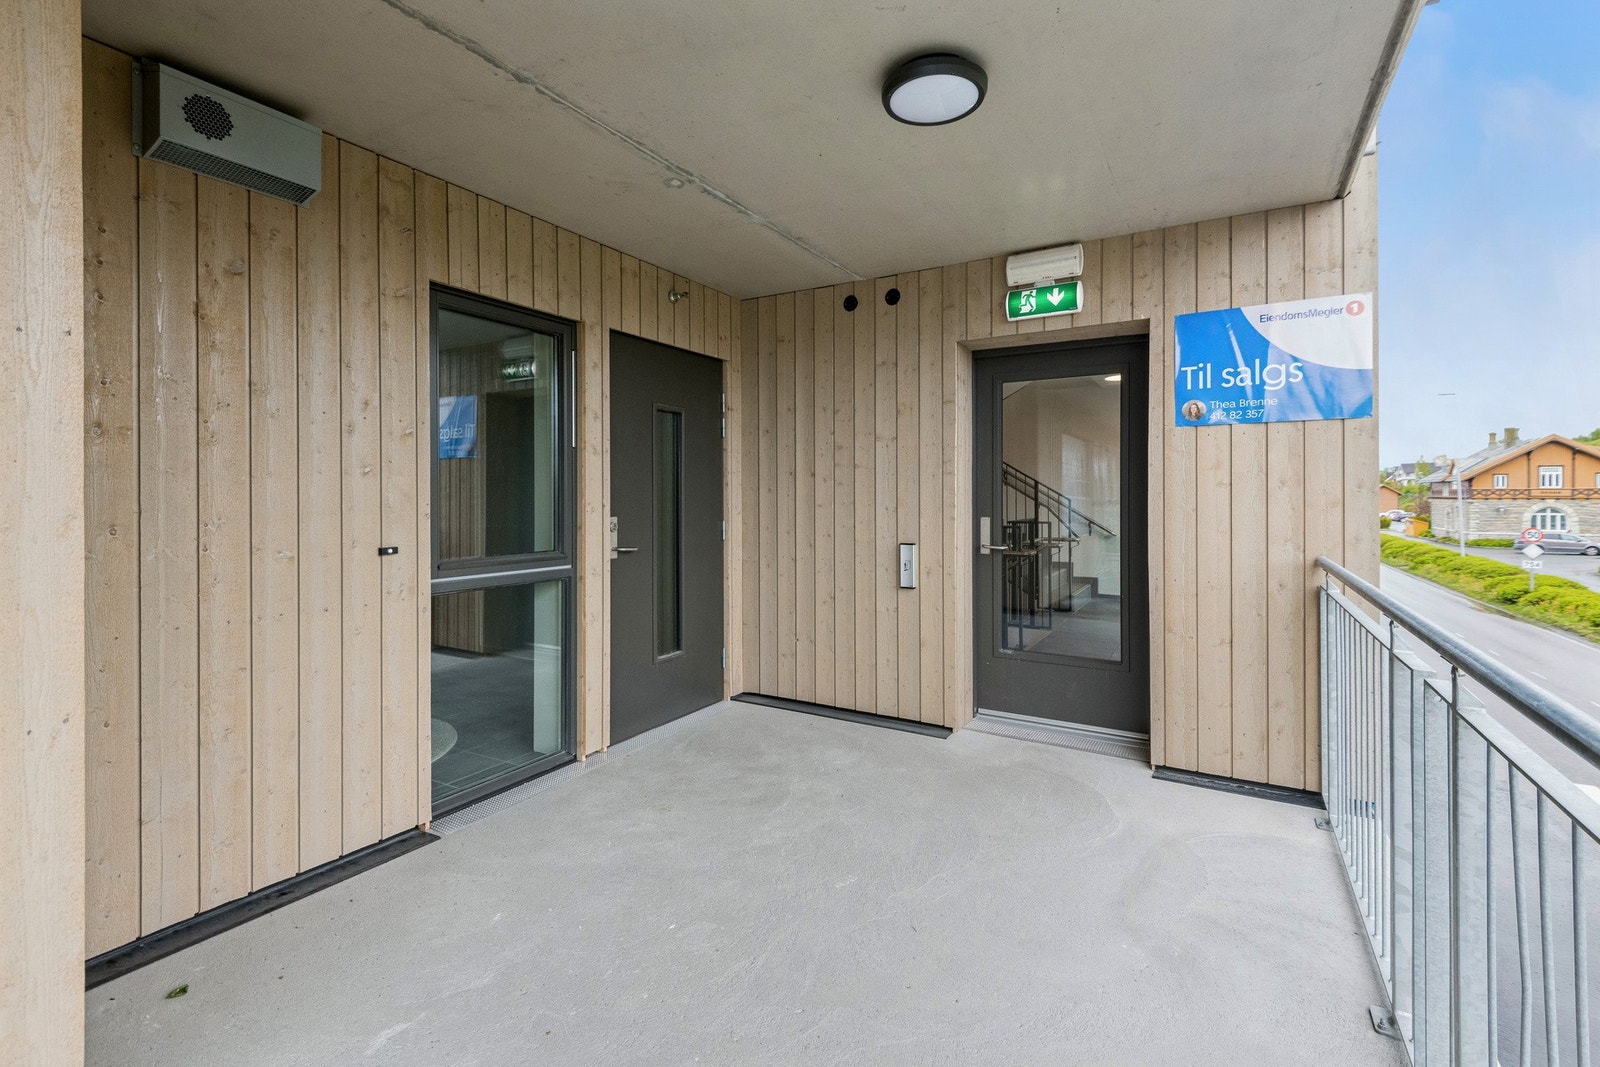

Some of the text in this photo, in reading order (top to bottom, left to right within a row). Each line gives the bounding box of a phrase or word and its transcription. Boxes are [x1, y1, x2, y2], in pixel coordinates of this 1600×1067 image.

[1259, 307, 1343, 323] EiendomsMegler
[1181, 358, 1304, 391] Til salgs
[1209, 397, 1278, 410] Thea Brenne
[1209, 408, 1265, 420] 412 82 357
[1527, 531, 1540, 540] 50
